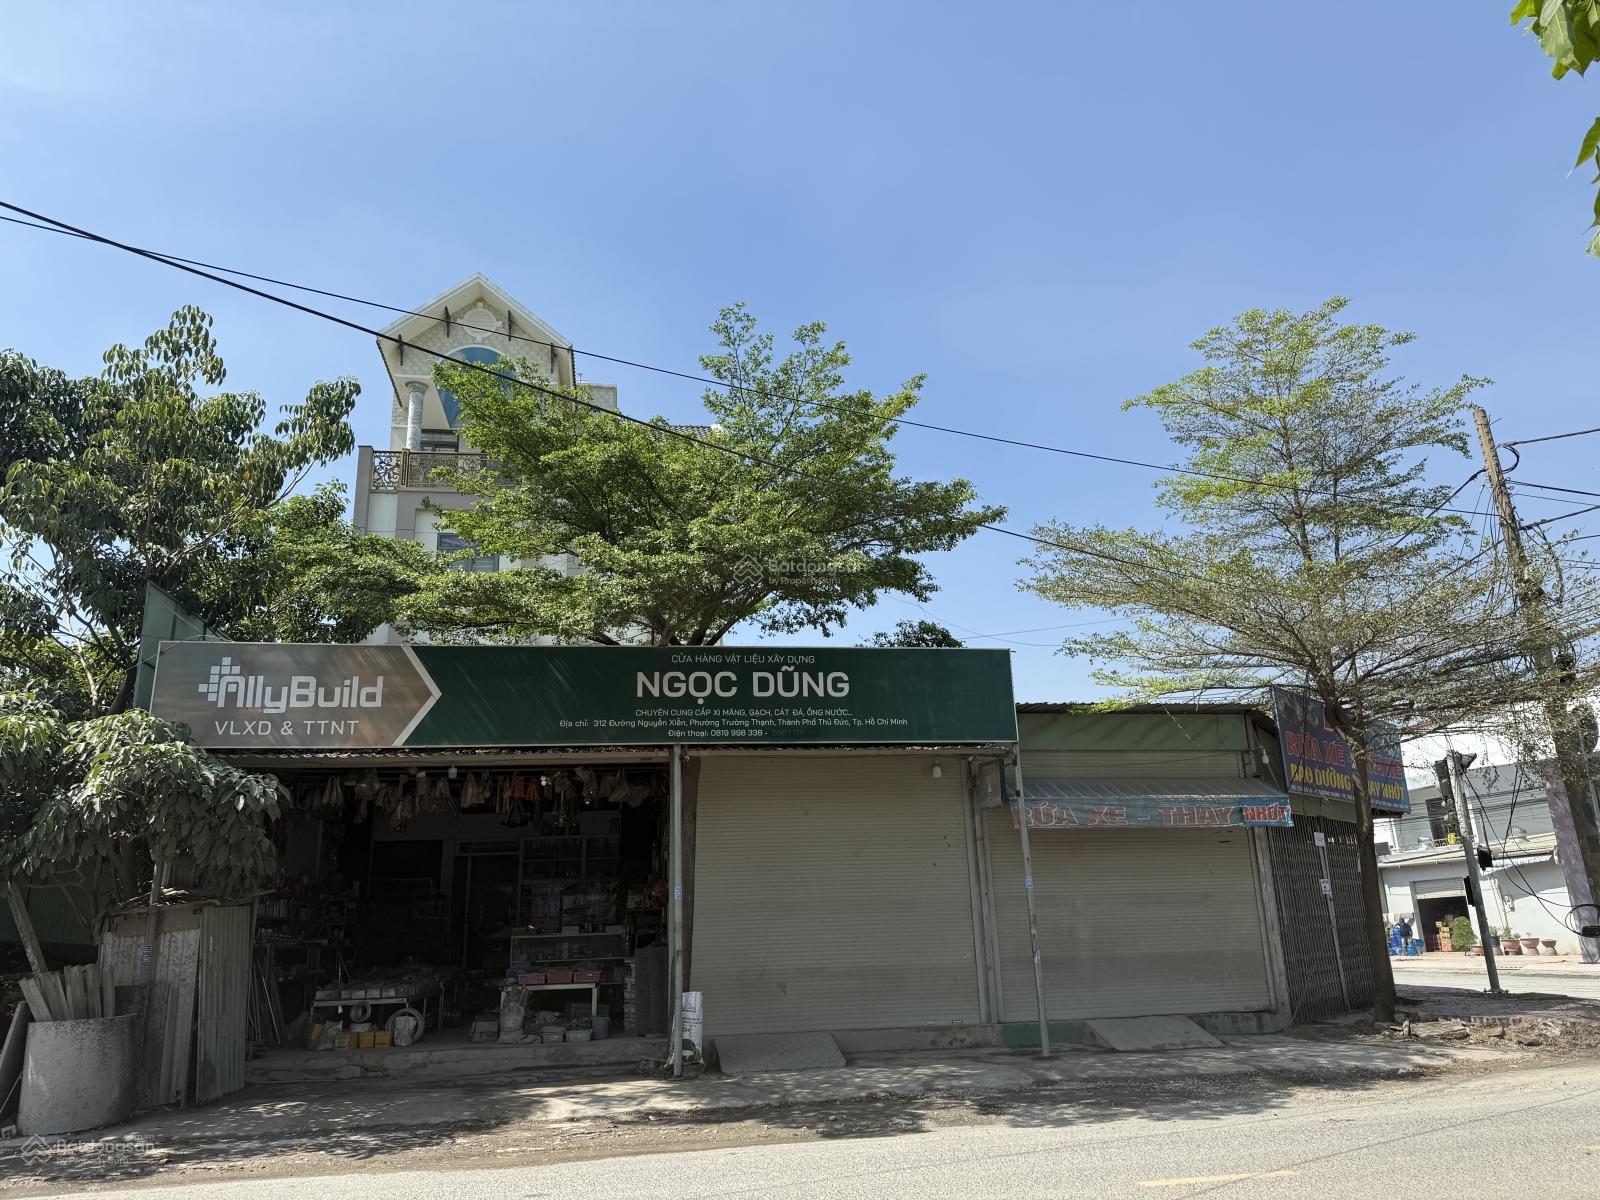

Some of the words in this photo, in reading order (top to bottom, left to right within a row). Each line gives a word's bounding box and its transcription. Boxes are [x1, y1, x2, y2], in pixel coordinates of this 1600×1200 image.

[671, 652, 693, 663] CỬA
[695, 653, 723, 663] HÀNG
[725, 653, 742, 665] VẬT
[744, 653, 765, 665] LIỆU
[767, 653, 785, 664] XÂY
[787, 655, 816, 665] DỰNG
[636, 671, 738, 705] NGỌC
[752, 665, 850, 698] DŨNG
[215, 675, 384, 714] AllyBuild
[635, 708, 669, 717] CHUYÊN
[670, 708, 693, 717] CUNG
[694, 706, 712, 717] CẤP
[713, 708, 721, 717] XI
[748, 708, 773, 718] GẠCH,
[774, 707, 790, 717] CÁT
[806, 706, 824, 717] ỐNG
[215, 720, 272, 736] VLXD
[280, 720, 294, 736] &
[303, 720, 360, 736] TTNT
[559, 719, 573, 729] Địa
[593, 719, 607, 728] 312
[608, 719, 636, 729] Đường
[637, 717, 668, 728] Nguyễn
[689, 718, 720, 728] Phường
[721, 718, 750, 728] Trường
[751, 718, 777, 727] Thạnh,
[778, 718, 801, 727] Thành
[801, 717, 817, 726] Phố
[818, 718, 832, 726] Thủ
[833, 718, 851, 727] Đức,
[852, 718, 864, 727] Tp.
[865, 716, 876, 726] Hồ
[876, 717, 889, 726] Chí
[890, 718, 908, 726] Minh
[668, 729, 686, 738] Điện
[710, 729, 729, 737] 0819
[747, 729, 763, 737] 338
[1323, 739, 1346, 767] XE
[1012, 801, 1079, 828] RỬA
[1087, 805, 1129, 825] XE
[1158, 805, 1235, 826] THAY
[1243, 802, 1289, 823] NHỚT
